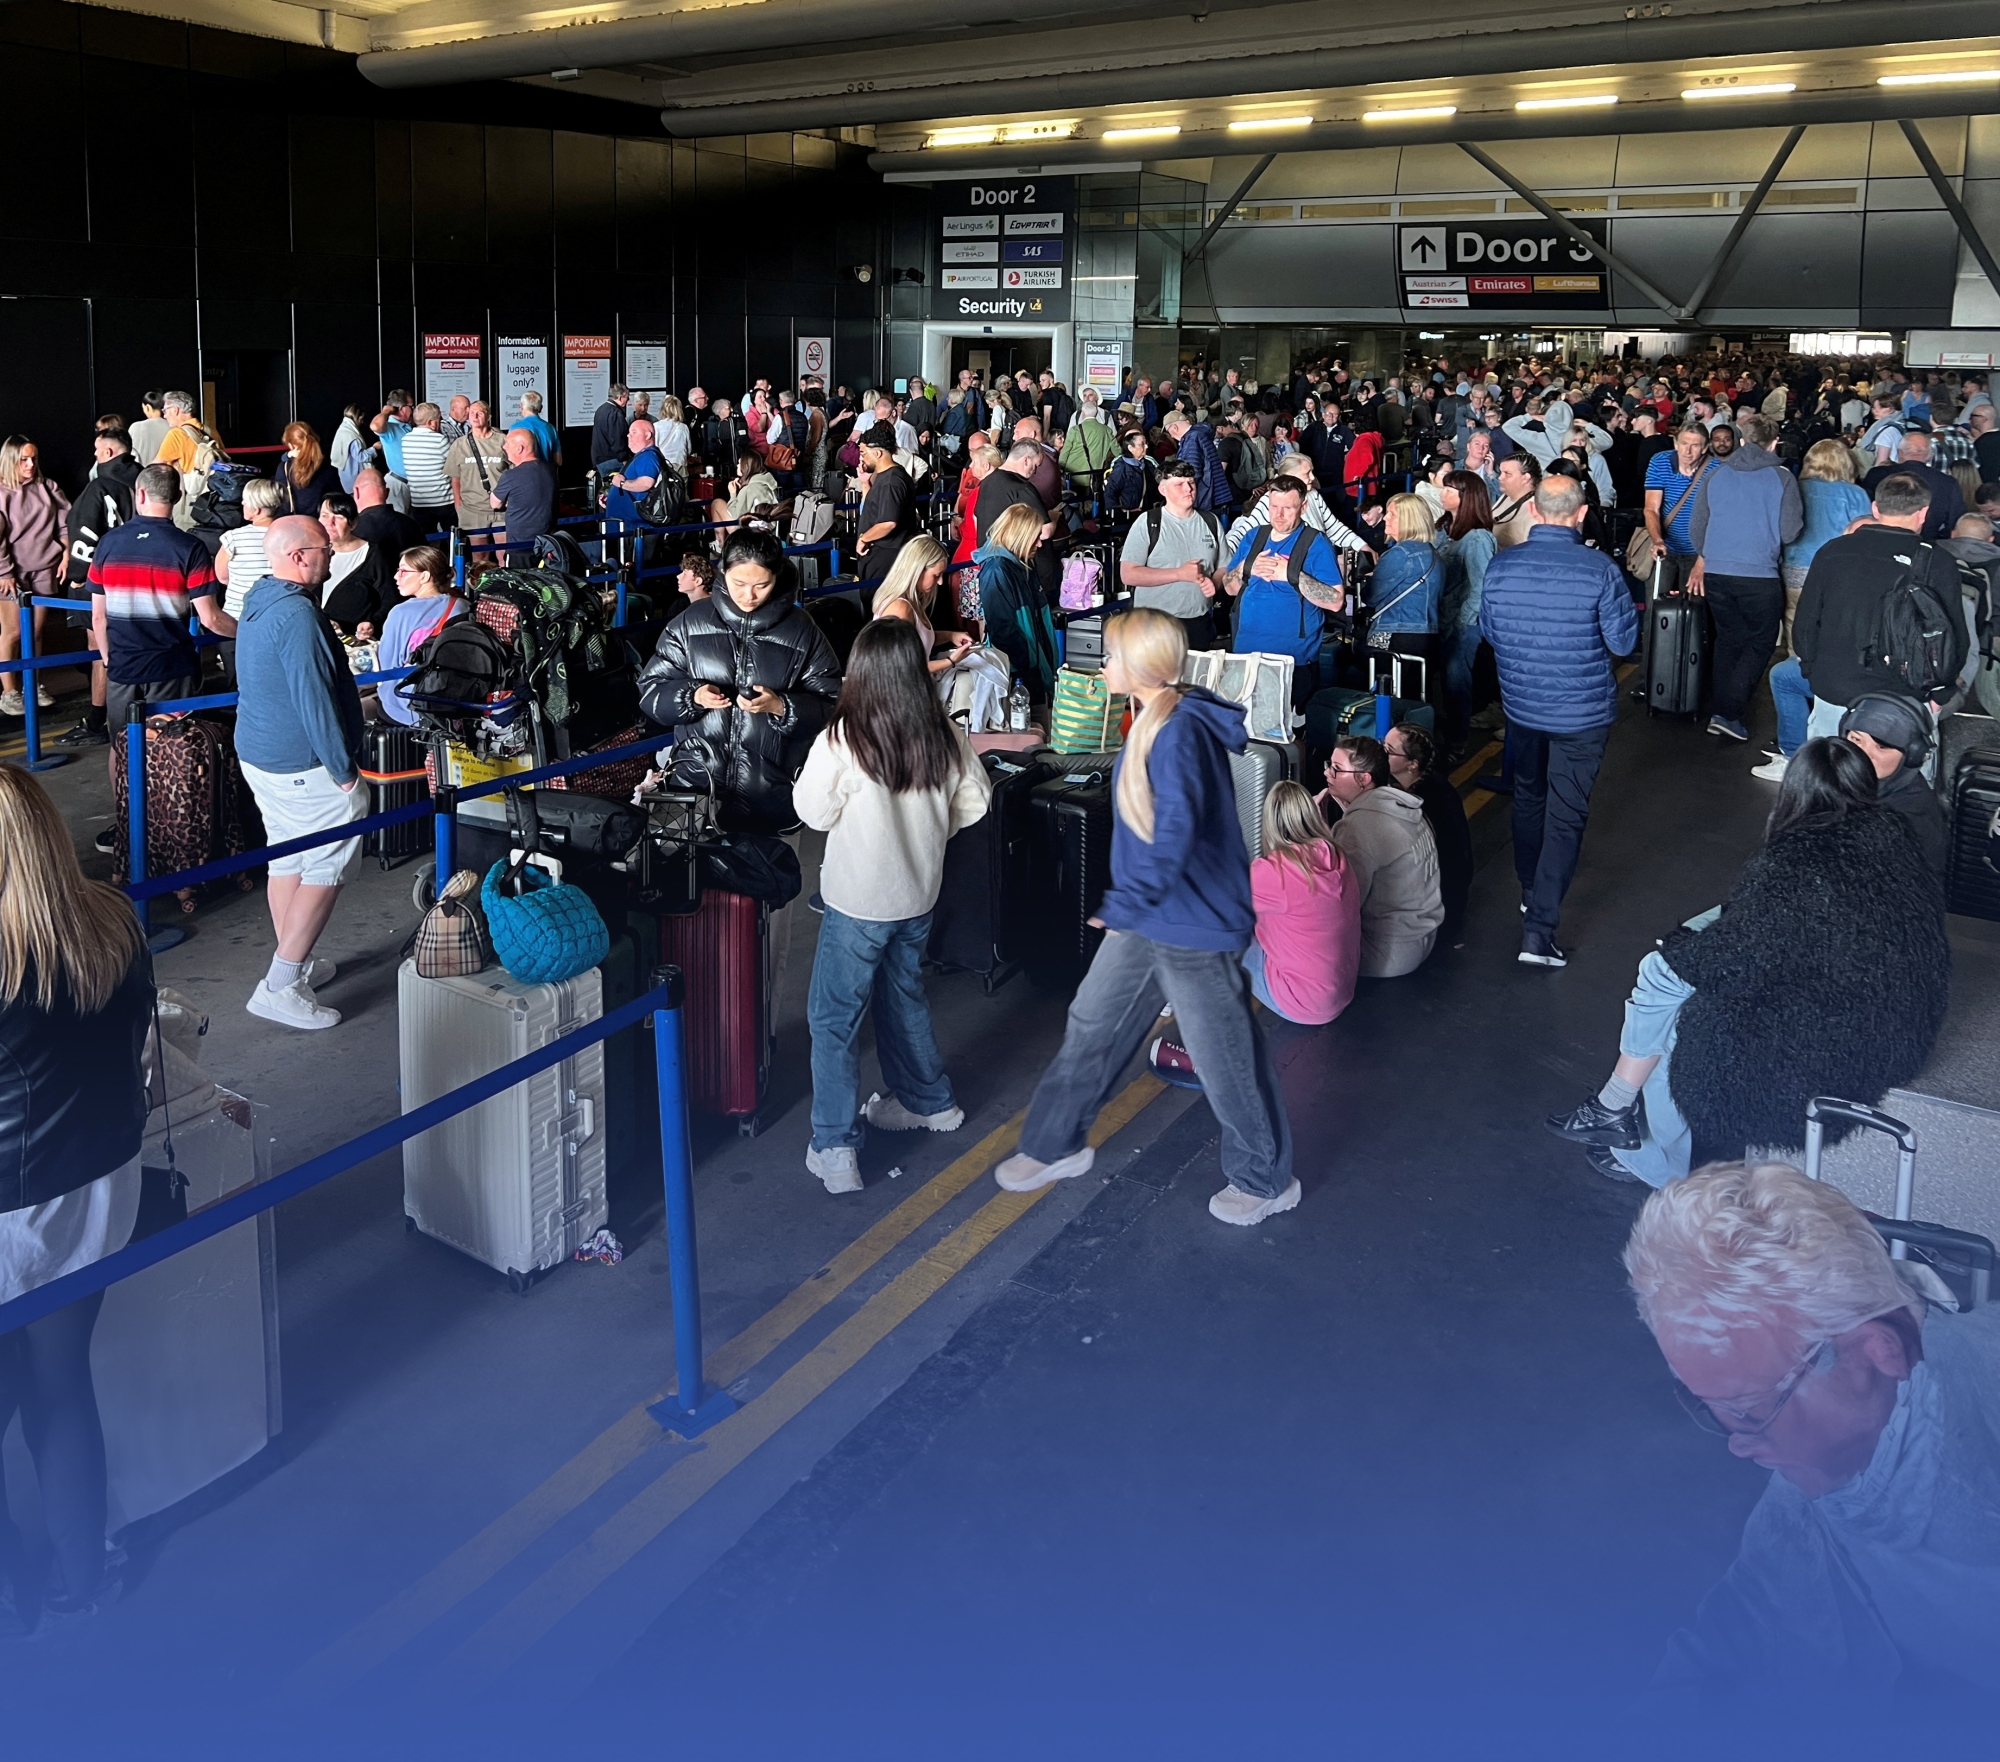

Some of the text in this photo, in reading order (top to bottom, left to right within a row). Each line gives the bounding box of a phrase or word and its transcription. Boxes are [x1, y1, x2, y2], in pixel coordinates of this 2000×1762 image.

[970, 184, 1036, 206] Door 2
[946, 222, 983, 232] Aer Lingus
[1021, 246, 1043, 257] SAS
[1456, 230, 1594, 263] Door 3
[1023, 278, 1056, 286] AIRLINES
[1412, 280, 1447, 288] Austrian
[1474, 279, 1526, 290] Emirates
[958, 297, 1026, 318] Security
[425, 336, 479, 347] IMPORTANT
[498, 336, 540, 346] Information
[564, 338, 610, 348] IMPORTANT
[1087, 344, 1111, 352] Door 3
[512, 350, 535, 360] Hand
[506, 364, 540, 375] luggage
[512, 377, 535, 388] only?
